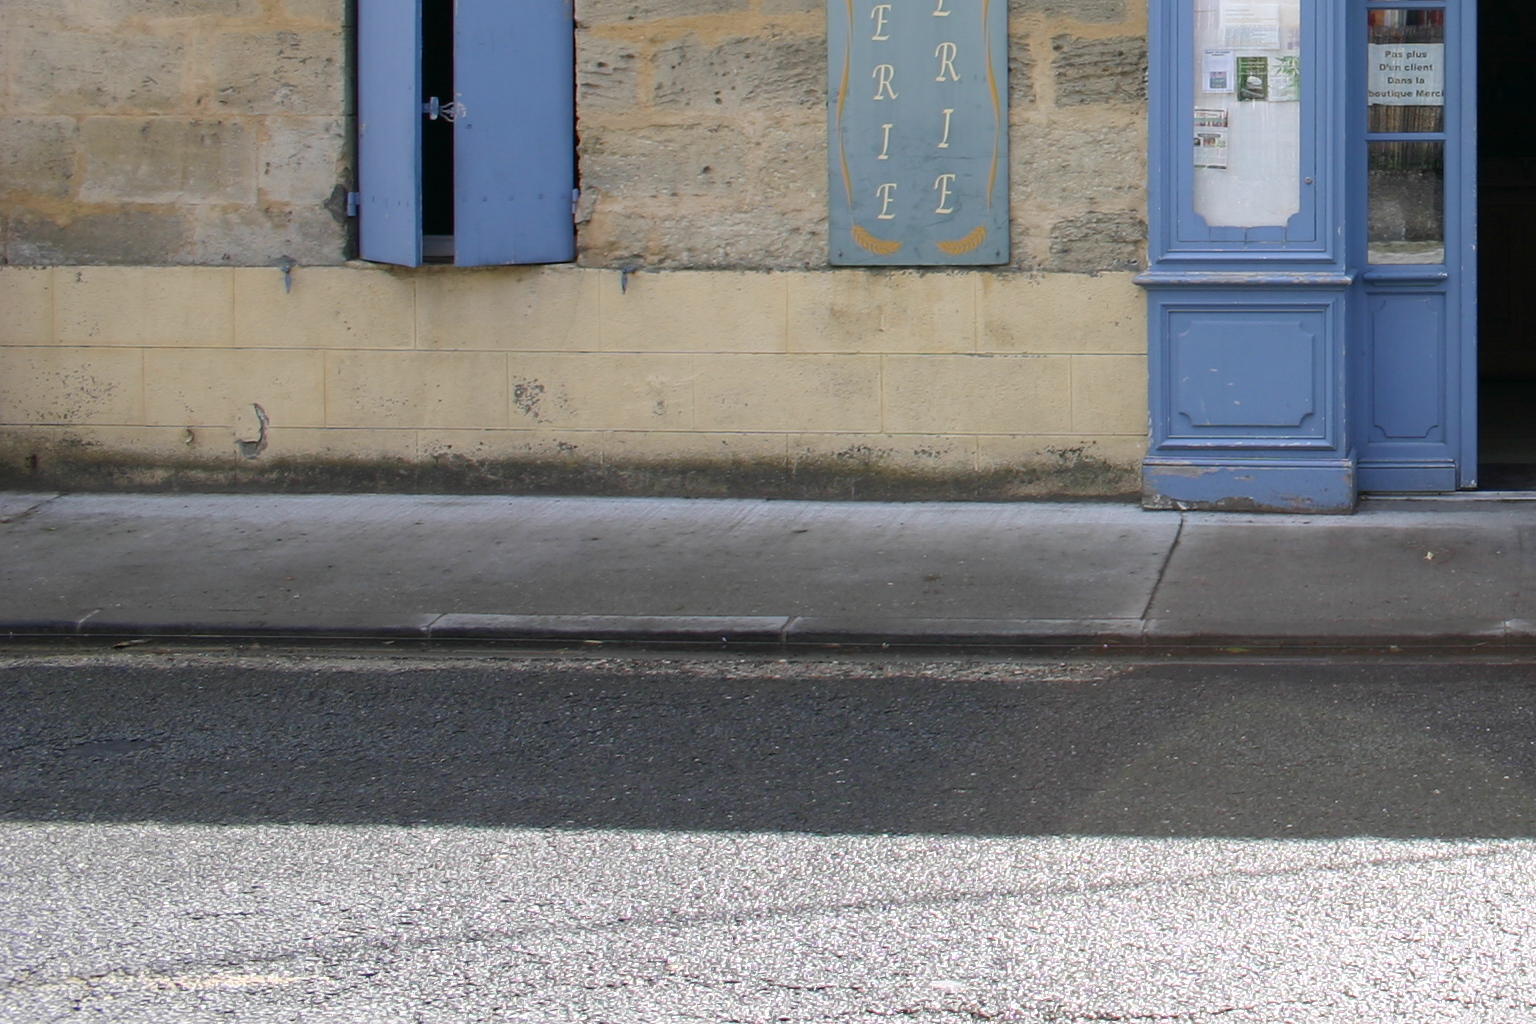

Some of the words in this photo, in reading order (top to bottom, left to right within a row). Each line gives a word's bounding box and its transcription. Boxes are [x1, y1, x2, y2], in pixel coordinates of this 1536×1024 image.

[1385, 50, 1403, 58] Pas
[1406, 50, 1427, 60] plus
[1404, 63, 1433, 71] client
[1416, 76, 1425, 84] la
